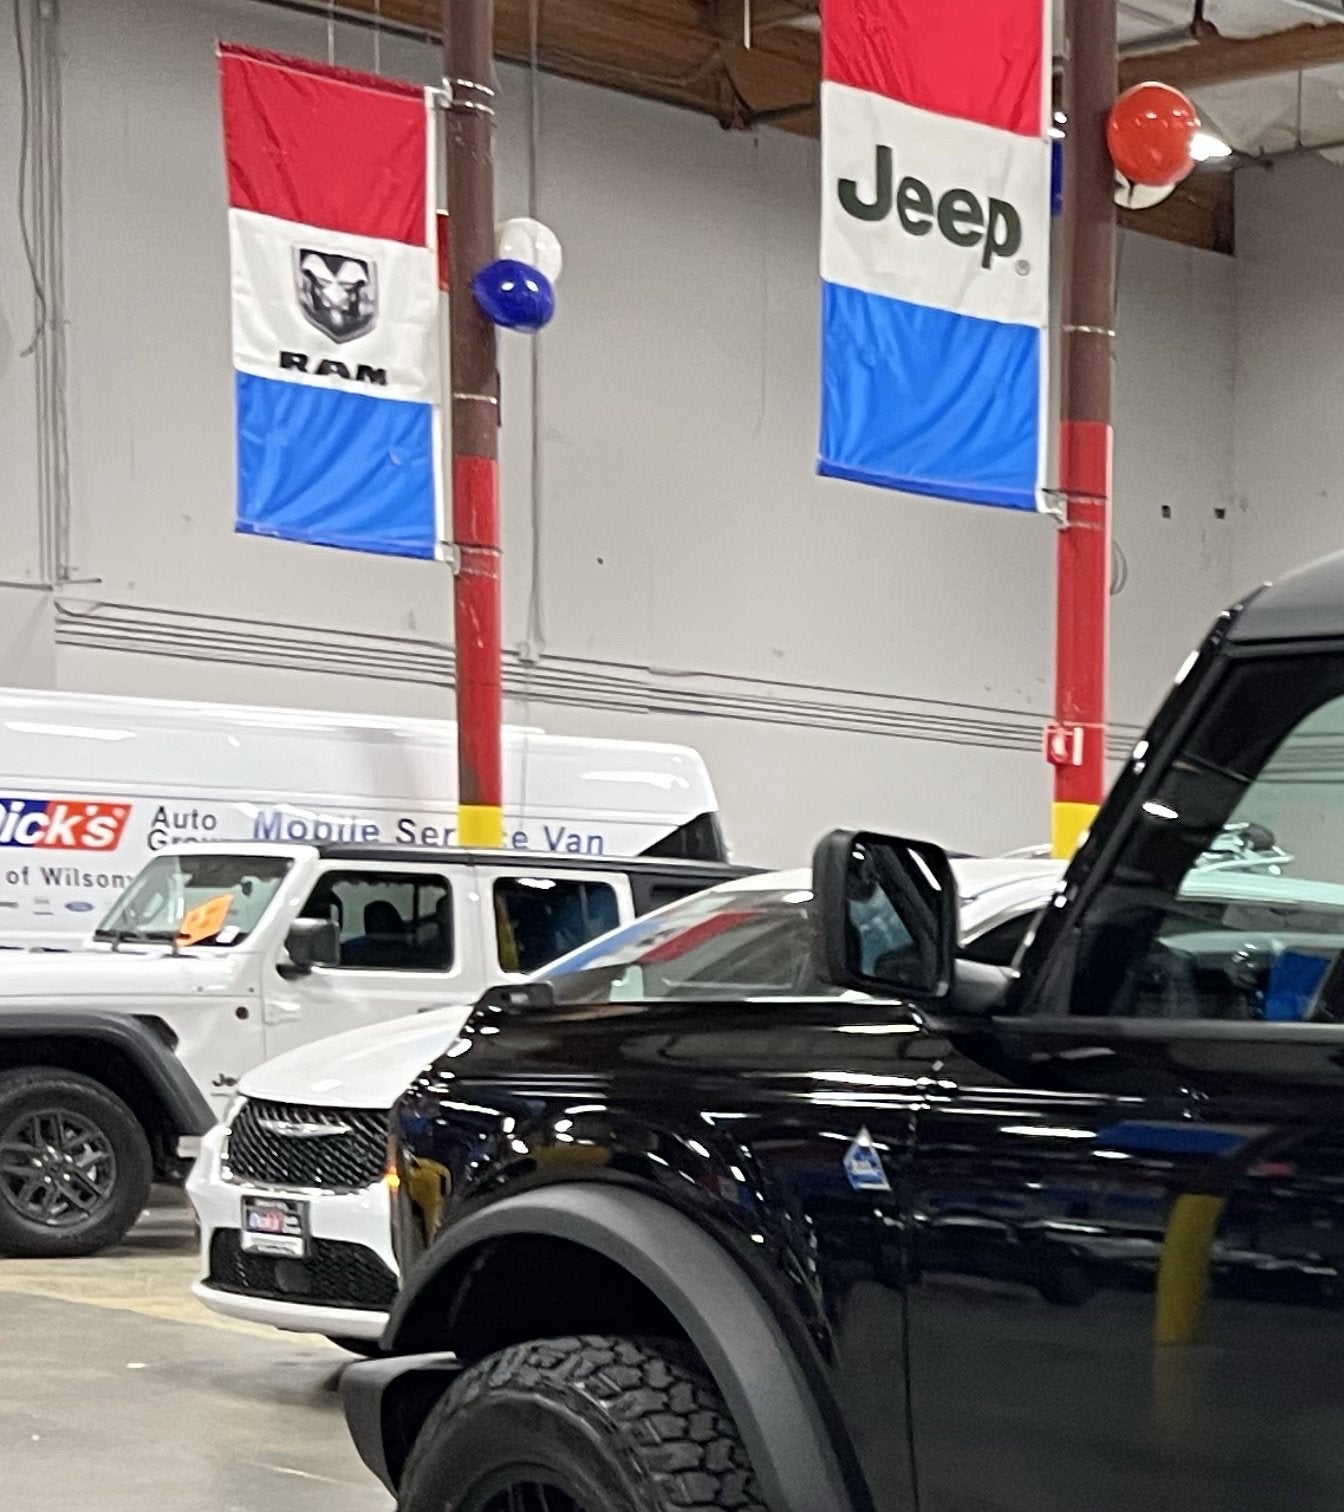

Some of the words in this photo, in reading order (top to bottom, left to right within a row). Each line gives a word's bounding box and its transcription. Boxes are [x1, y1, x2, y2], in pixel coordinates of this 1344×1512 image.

[837, 143, 1023, 270] Jeep
[279, 350, 388, 386] RAM
[0, 801, 118, 848] ick's
[151, 805, 217, 830] Auto
[396, 818, 529, 849] Sere
[545, 826, 604, 855] Van
[6, 866, 30, 885] of
